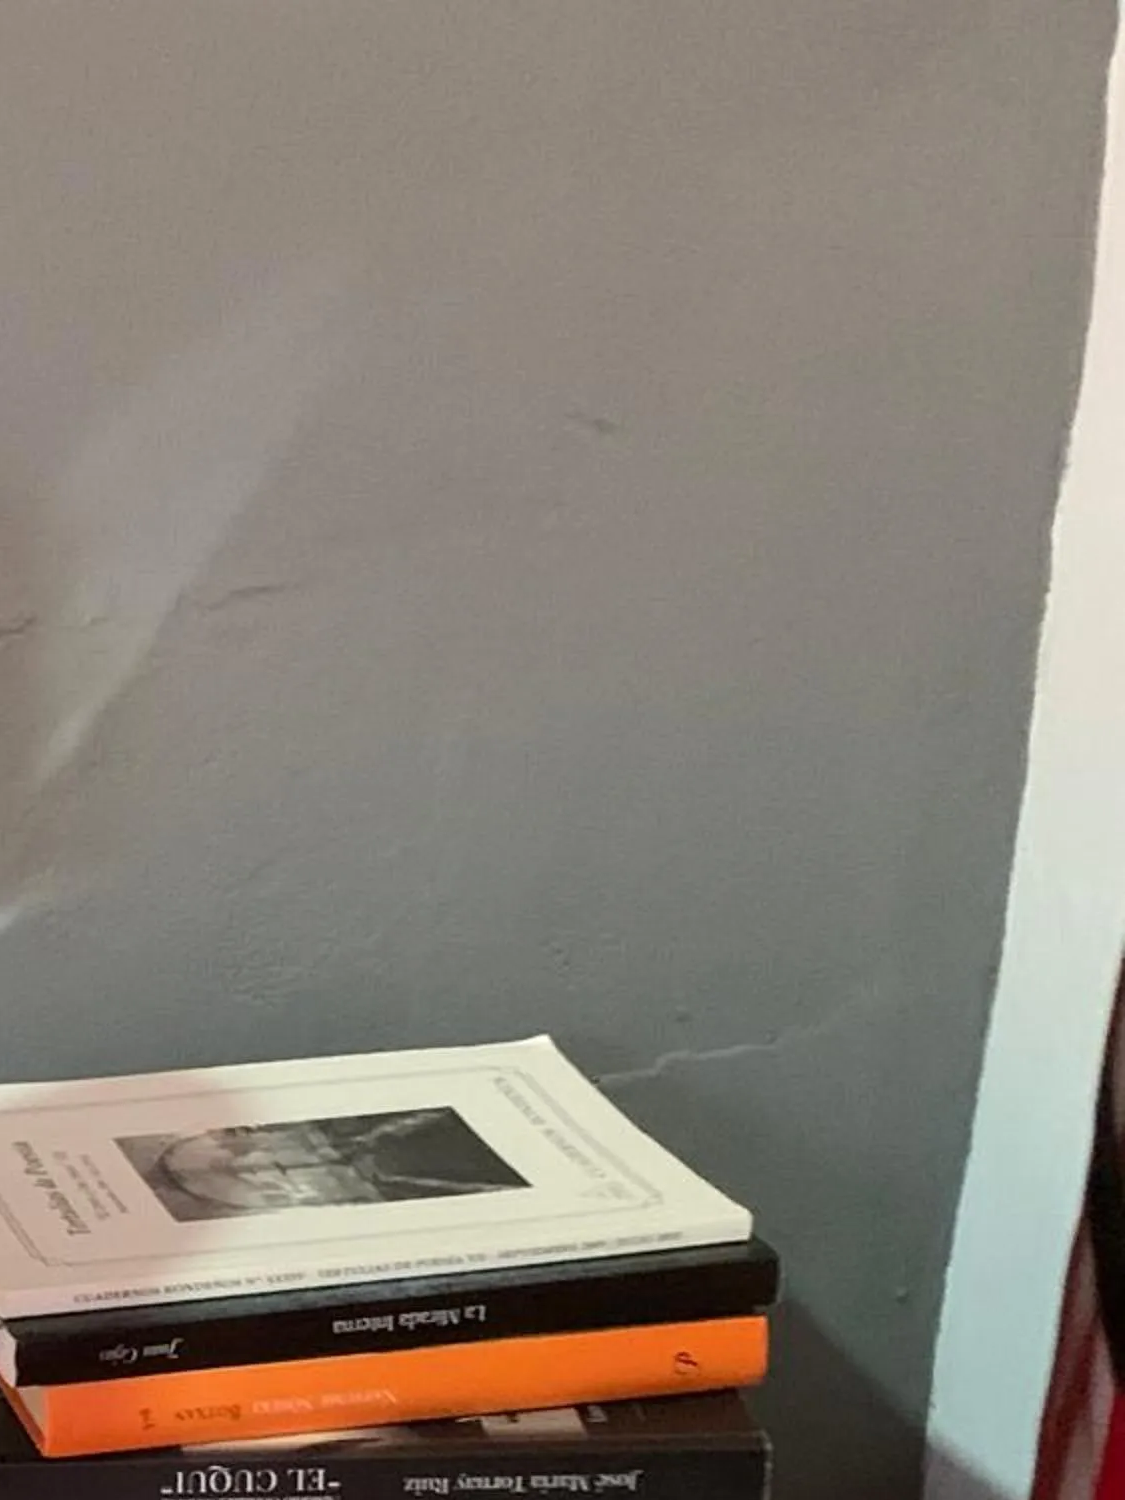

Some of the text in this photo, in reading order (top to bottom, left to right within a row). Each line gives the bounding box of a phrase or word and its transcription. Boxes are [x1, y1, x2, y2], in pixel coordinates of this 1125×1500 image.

[331, 1303, 485, 1335] La Mirada Interna
[141, 1335, 184, 1358] Juan
[401, 1475, 449, 1497] Ruiz
[454, 1471, 528, 1493] Tornay
[593, 1468, 643, 1492] José
